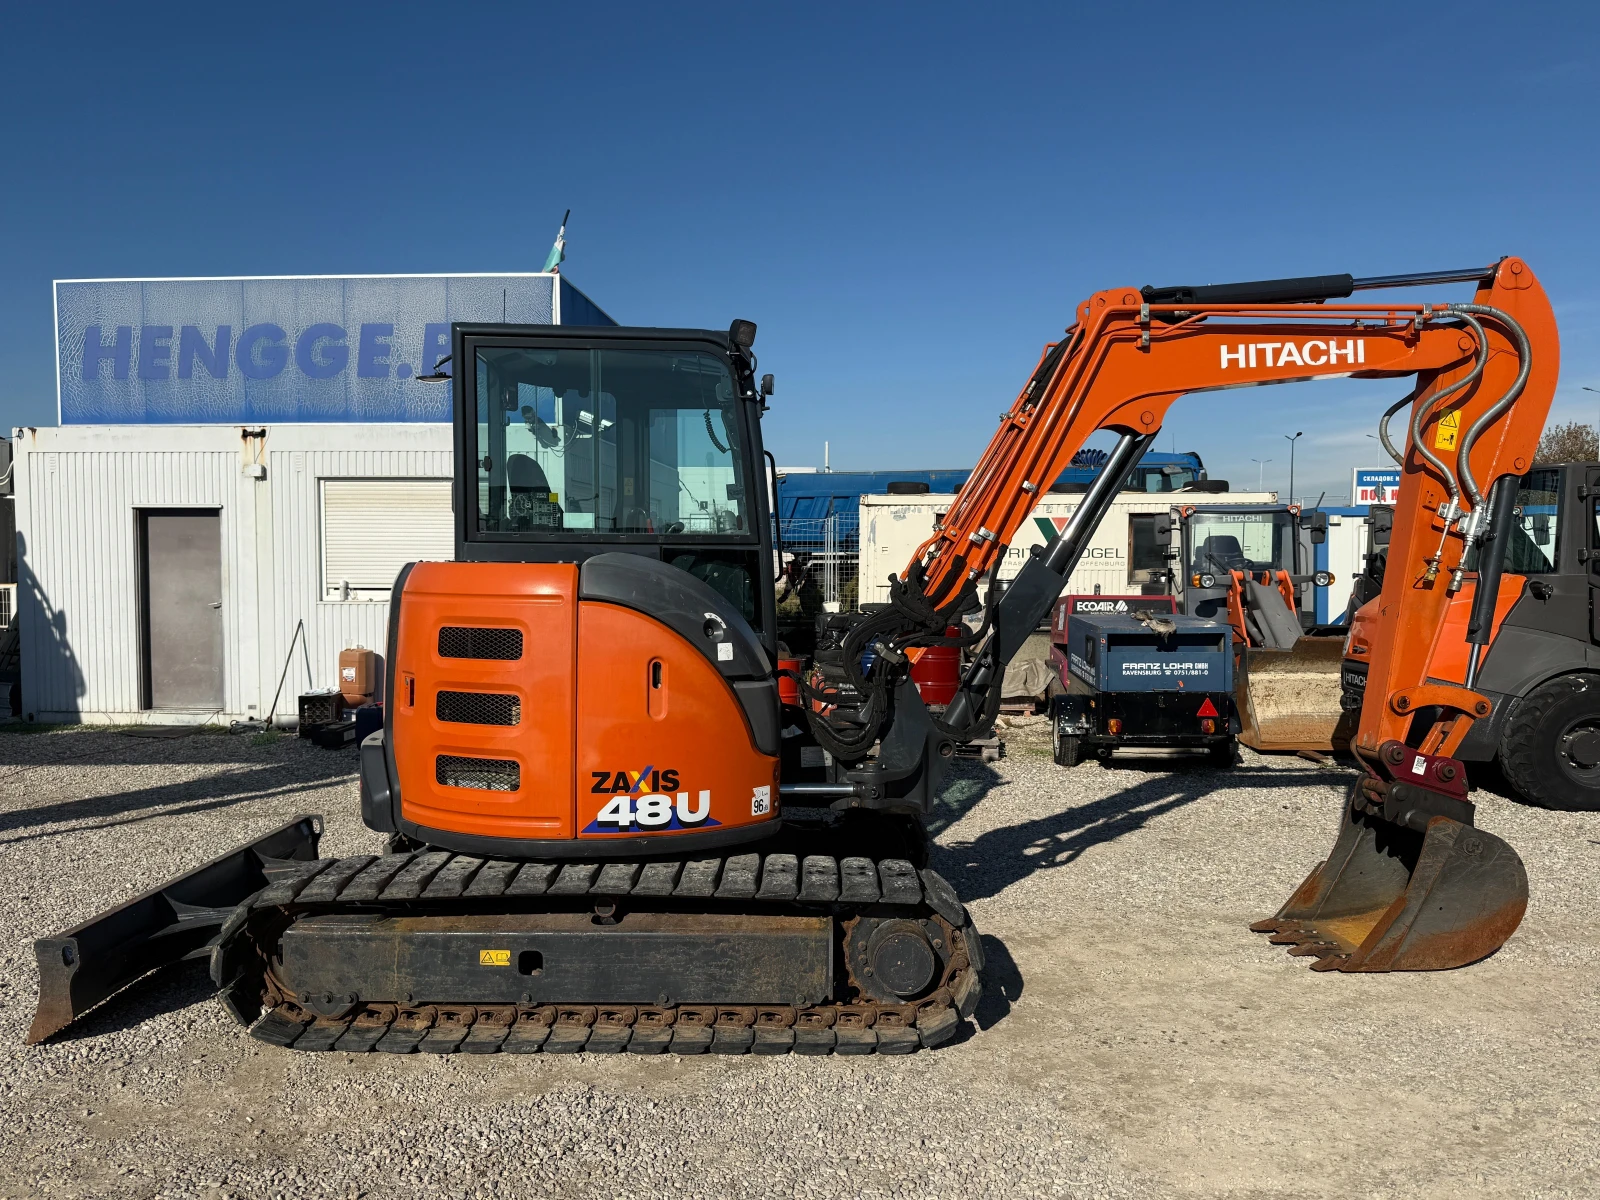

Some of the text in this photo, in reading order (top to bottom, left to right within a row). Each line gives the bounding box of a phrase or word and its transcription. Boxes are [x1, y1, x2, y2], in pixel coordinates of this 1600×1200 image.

[82, 322, 452, 380] HENGGE.B
[1220, 339, 1365, 369] HITACHI
[1080, 547, 1125, 559] OGEL
[1077, 602, 1115, 611] ECOAIR
[1345, 672, 1368, 687] HITACH
[591, 765, 680, 794] ZAXIS
[597, 790, 711, 832] 48U
[753, 798, 764, 813] 96
